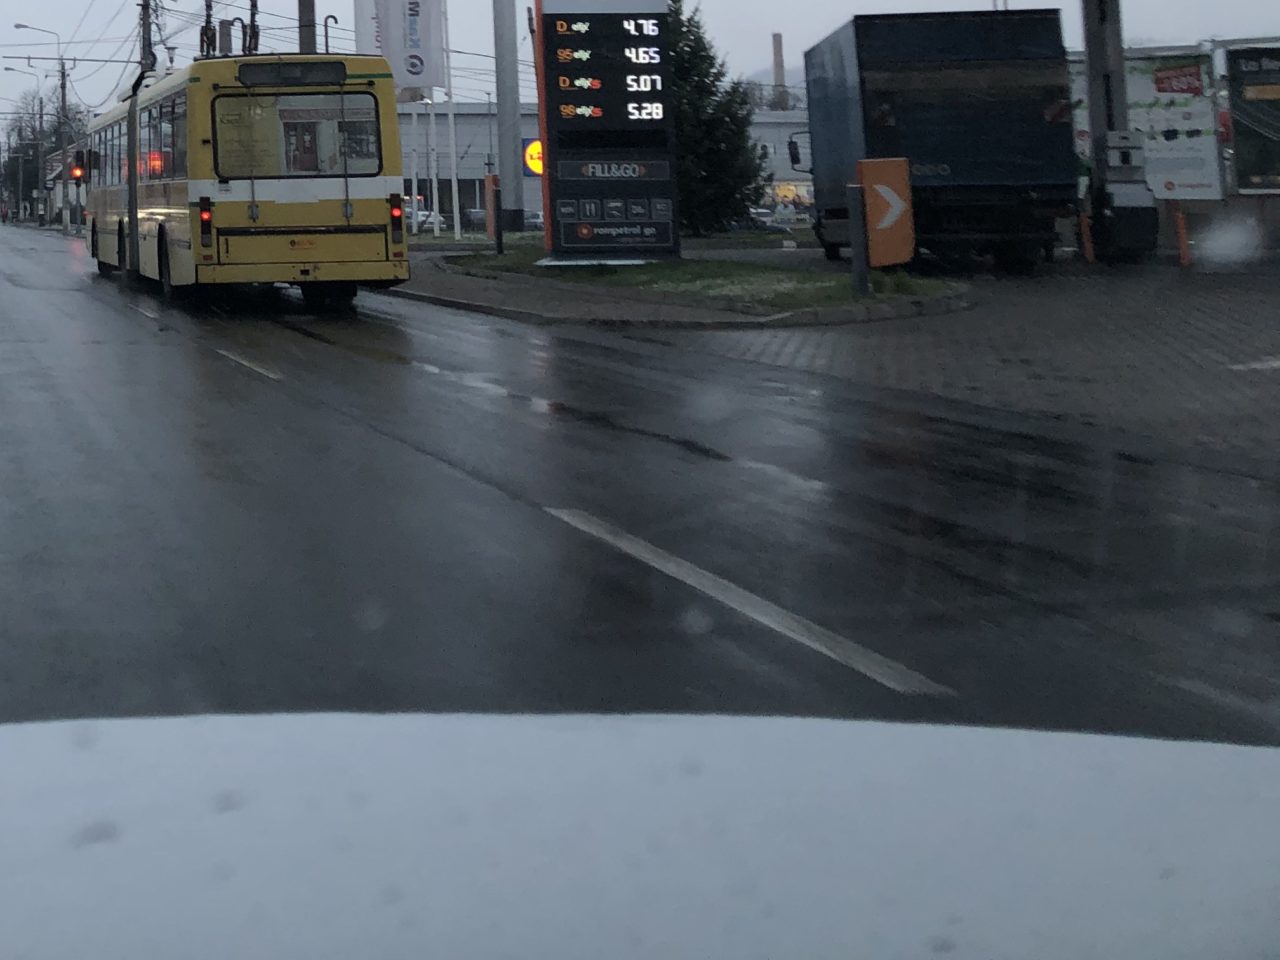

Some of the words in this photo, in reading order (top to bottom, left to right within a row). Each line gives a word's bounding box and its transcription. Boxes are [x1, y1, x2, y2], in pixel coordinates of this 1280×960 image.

[623, 19, 659, 36] 4.76
[624, 47, 661, 64] 4.65
[626, 74, 662, 92] 5.07
[627, 102, 664, 120] 5.28
[588, 163, 640, 177] FILL&GO
